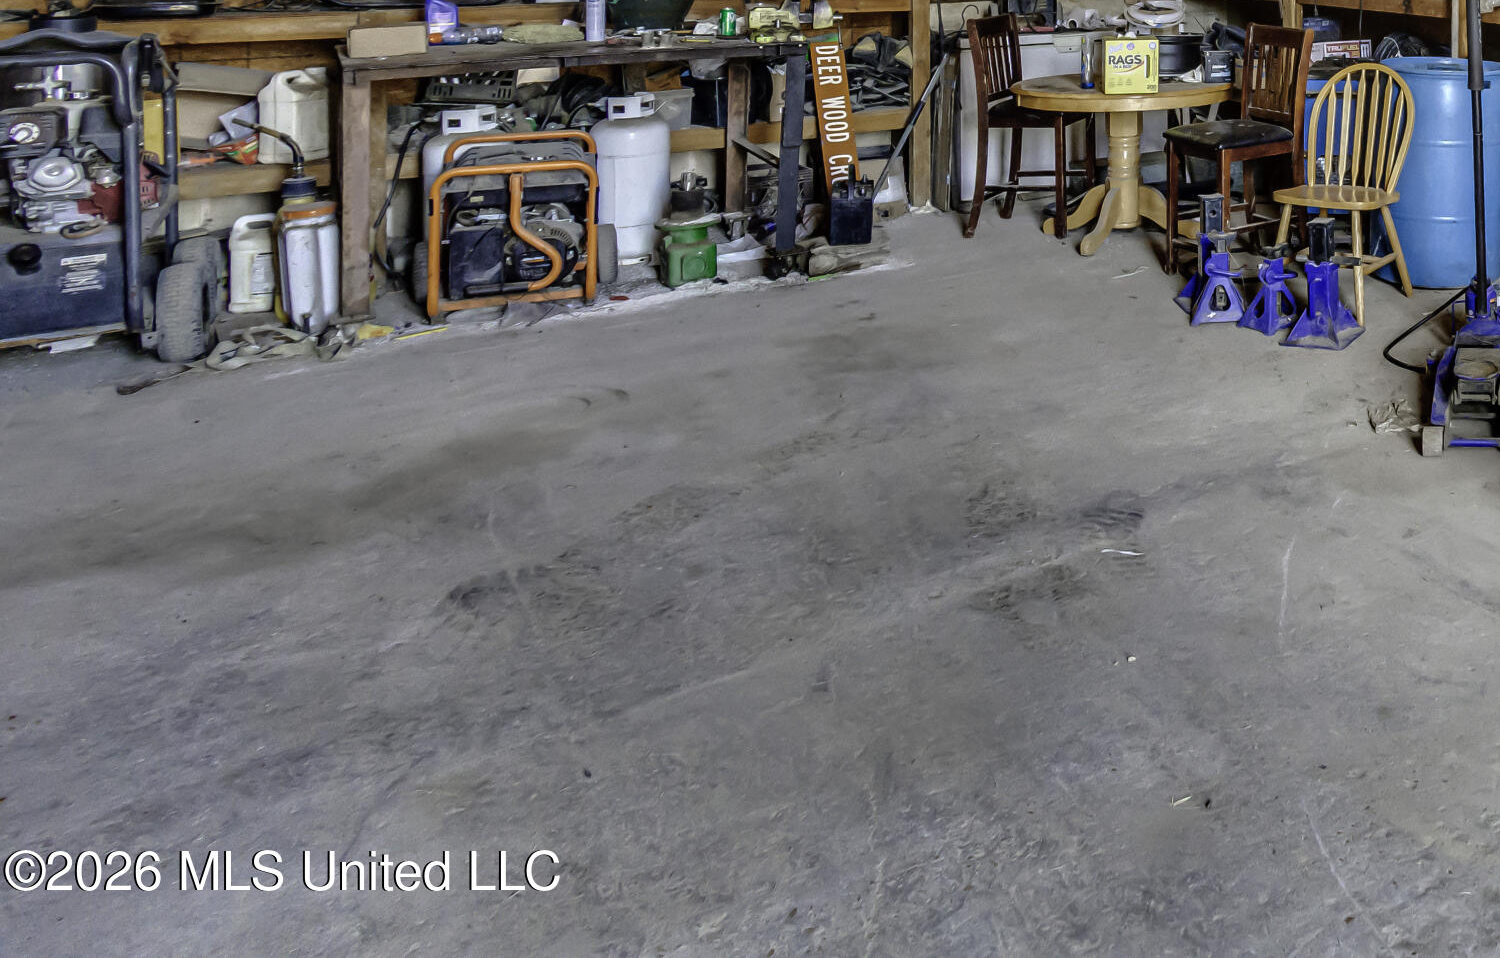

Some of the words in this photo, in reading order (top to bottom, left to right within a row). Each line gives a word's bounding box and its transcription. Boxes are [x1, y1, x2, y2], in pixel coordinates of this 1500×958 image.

[815, 45, 843, 85] DEER
[1108, 55, 1142, 65] RAGS
[821, 96, 850, 143] WOOD
[828, 154, 853, 184] CR
